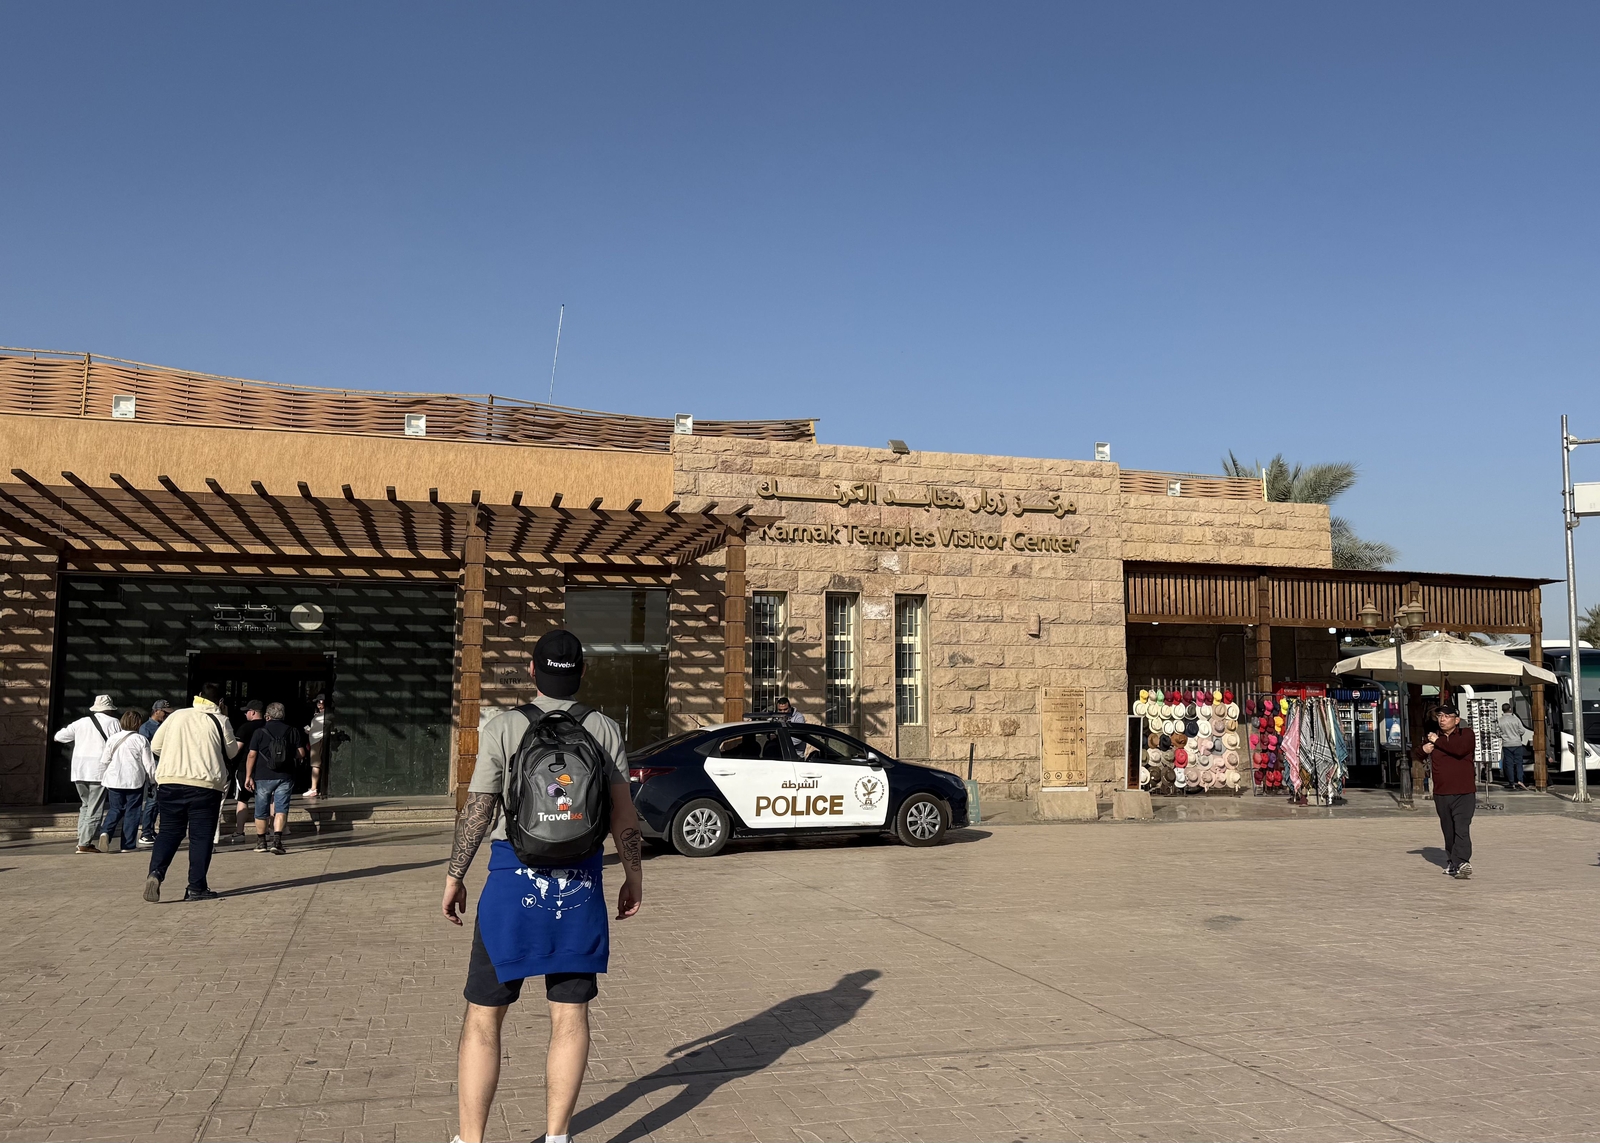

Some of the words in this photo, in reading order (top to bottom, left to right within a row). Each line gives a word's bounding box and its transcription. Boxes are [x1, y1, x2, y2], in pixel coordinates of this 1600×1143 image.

[756, 477, 877, 508] الكرنك
[882, 486, 965, 512] معابد
[969, 488, 1007, 515] زوار
[1013, 493, 1077, 518] مركز
[758, 520, 841, 544] Karnak
[844, 524, 936, 549] Temples
[937, 526, 1007, 550] Visitor
[1010, 531, 1080, 553] Center
[214, 624, 243, 632] Karnak
[245, 624, 277, 633] Temples
[781, 779, 818, 791] الشرطة
[537, 811, 583, 821] Travel365
[755, 795, 844, 817] POLICE
